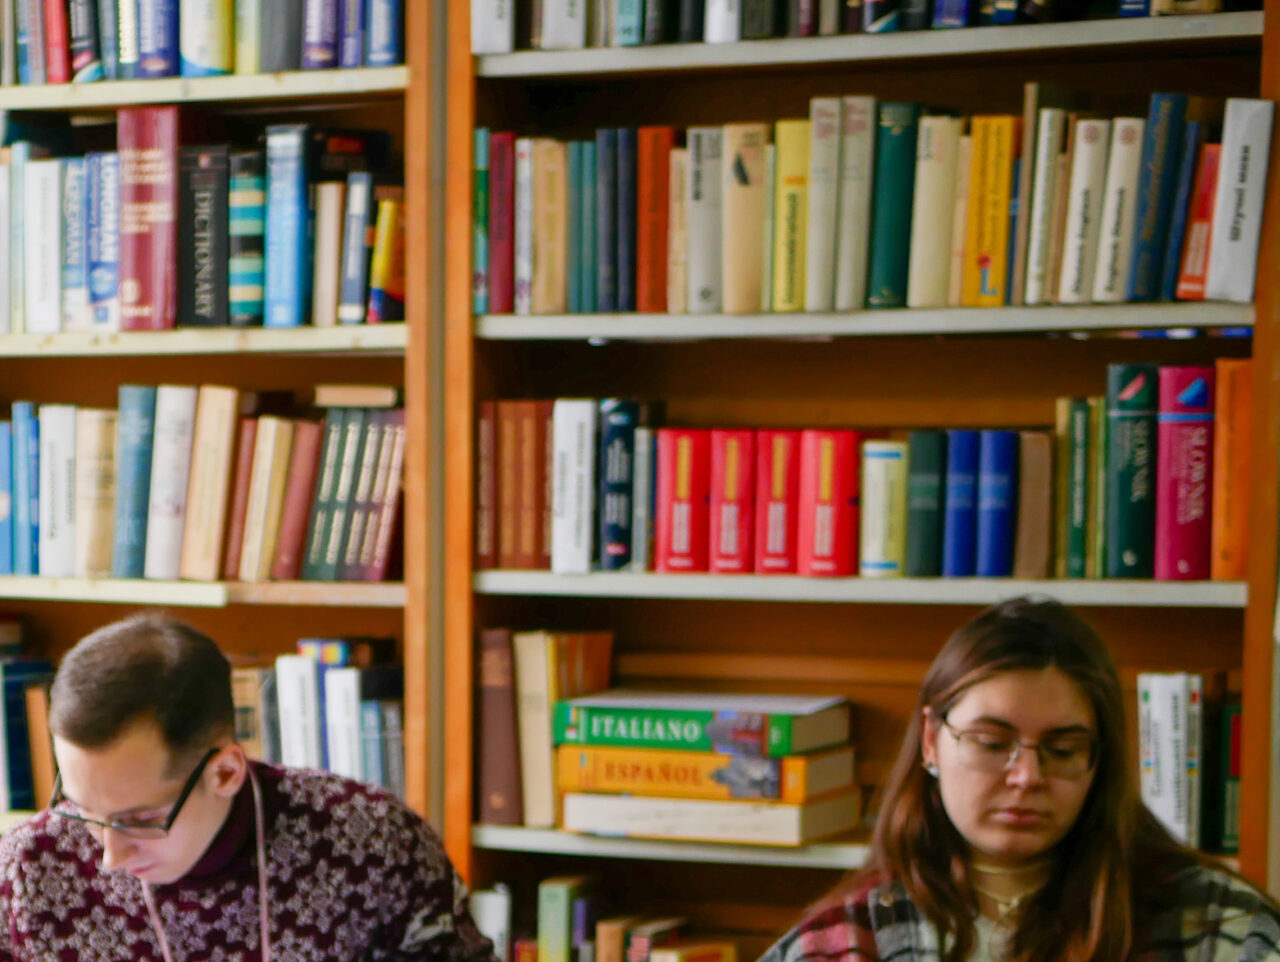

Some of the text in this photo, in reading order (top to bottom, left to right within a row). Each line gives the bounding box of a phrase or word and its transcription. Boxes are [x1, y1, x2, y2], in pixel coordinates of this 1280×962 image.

[100, 155, 119, 262] LONGMAN
[194, 190, 216, 318] DICTIONARY
[590, 714, 702, 743] ITALIANO
[603, 758, 703, 786] ESPAÑOL
